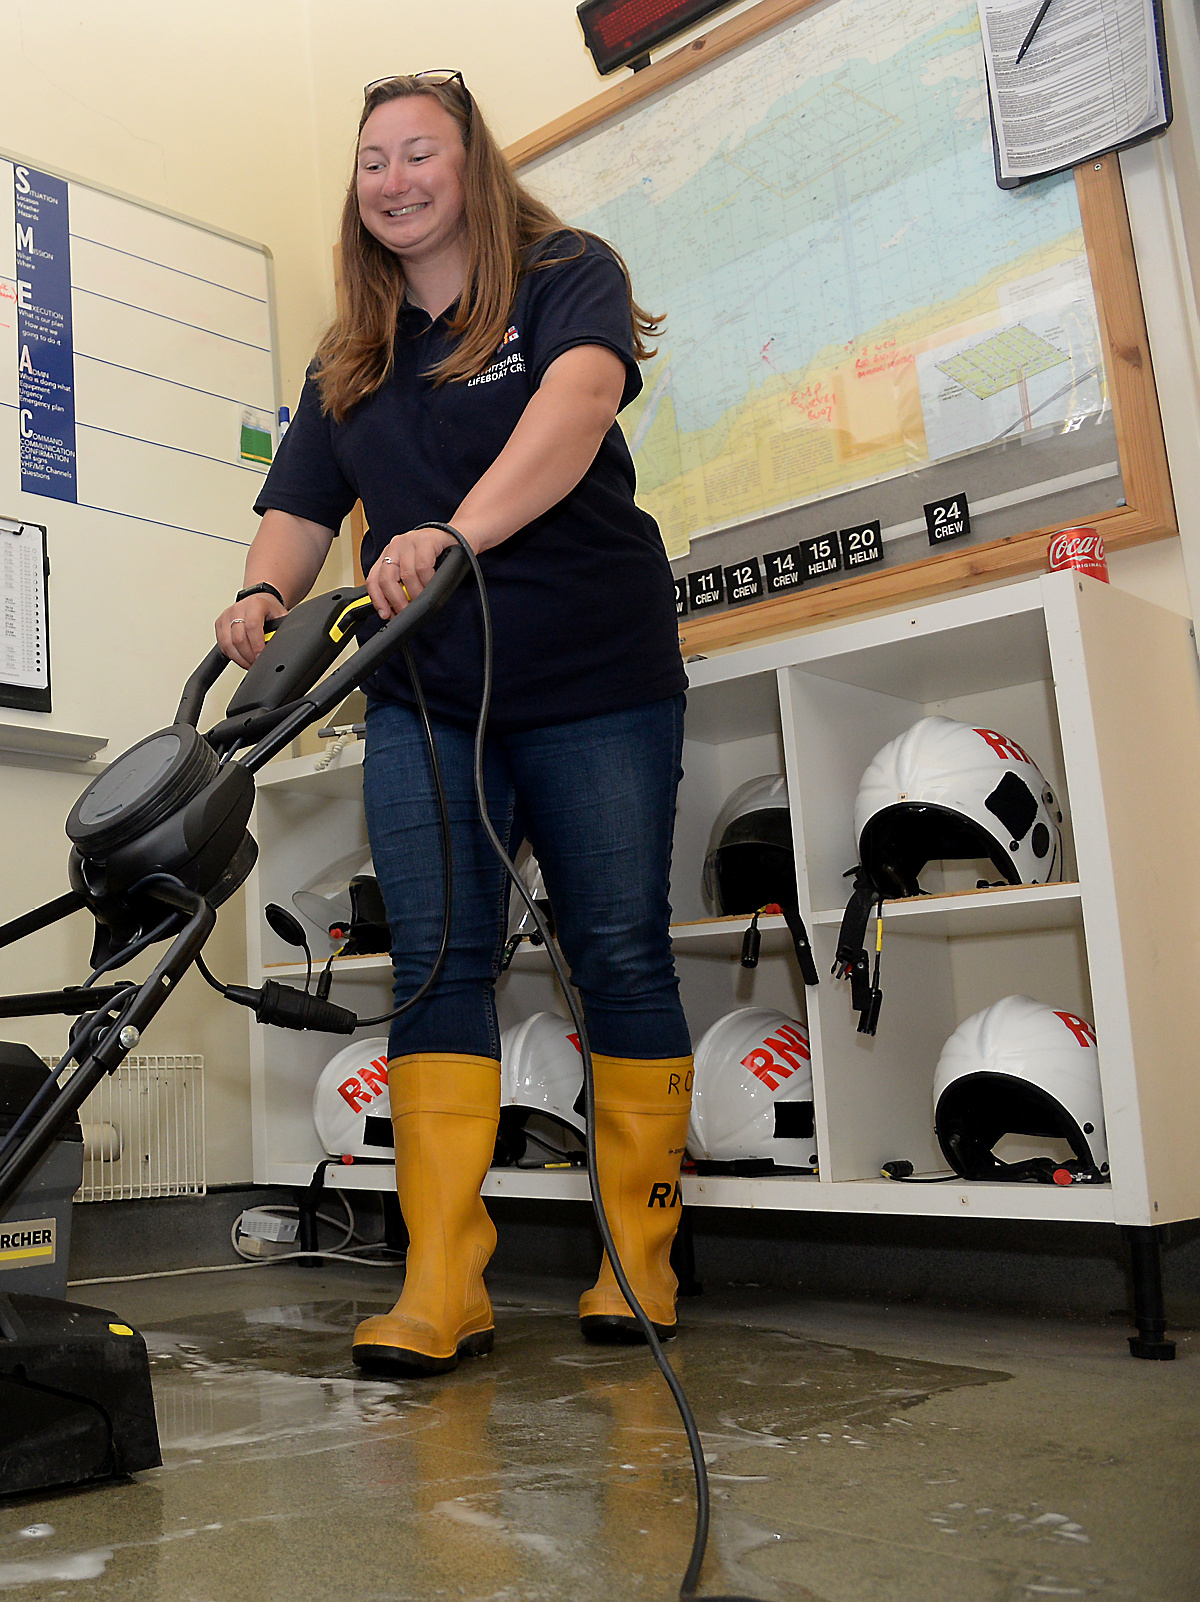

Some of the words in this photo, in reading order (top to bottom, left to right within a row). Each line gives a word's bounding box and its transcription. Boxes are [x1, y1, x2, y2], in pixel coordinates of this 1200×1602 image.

[467, 367, 508, 387] LIFEBOAT
[20, 438, 76, 458] COMMUNICATION
[20, 446, 70, 463] CONFIRMATION
[933, 501, 961, 526] 24
[934, 520, 964, 539] CREW
[848, 529, 875, 550] 20
[809, 540, 831, 560] 15
[849, 547, 879, 565] HELM
[772, 554, 795, 574] 14
[808, 558, 837, 575] HELM
[697, 573, 714, 591] 11
[732, 566, 753, 585] 12
[773, 572, 799, 588] CREW
[695, 590, 720, 605] CREW
[733, 583, 758, 599] CREW
